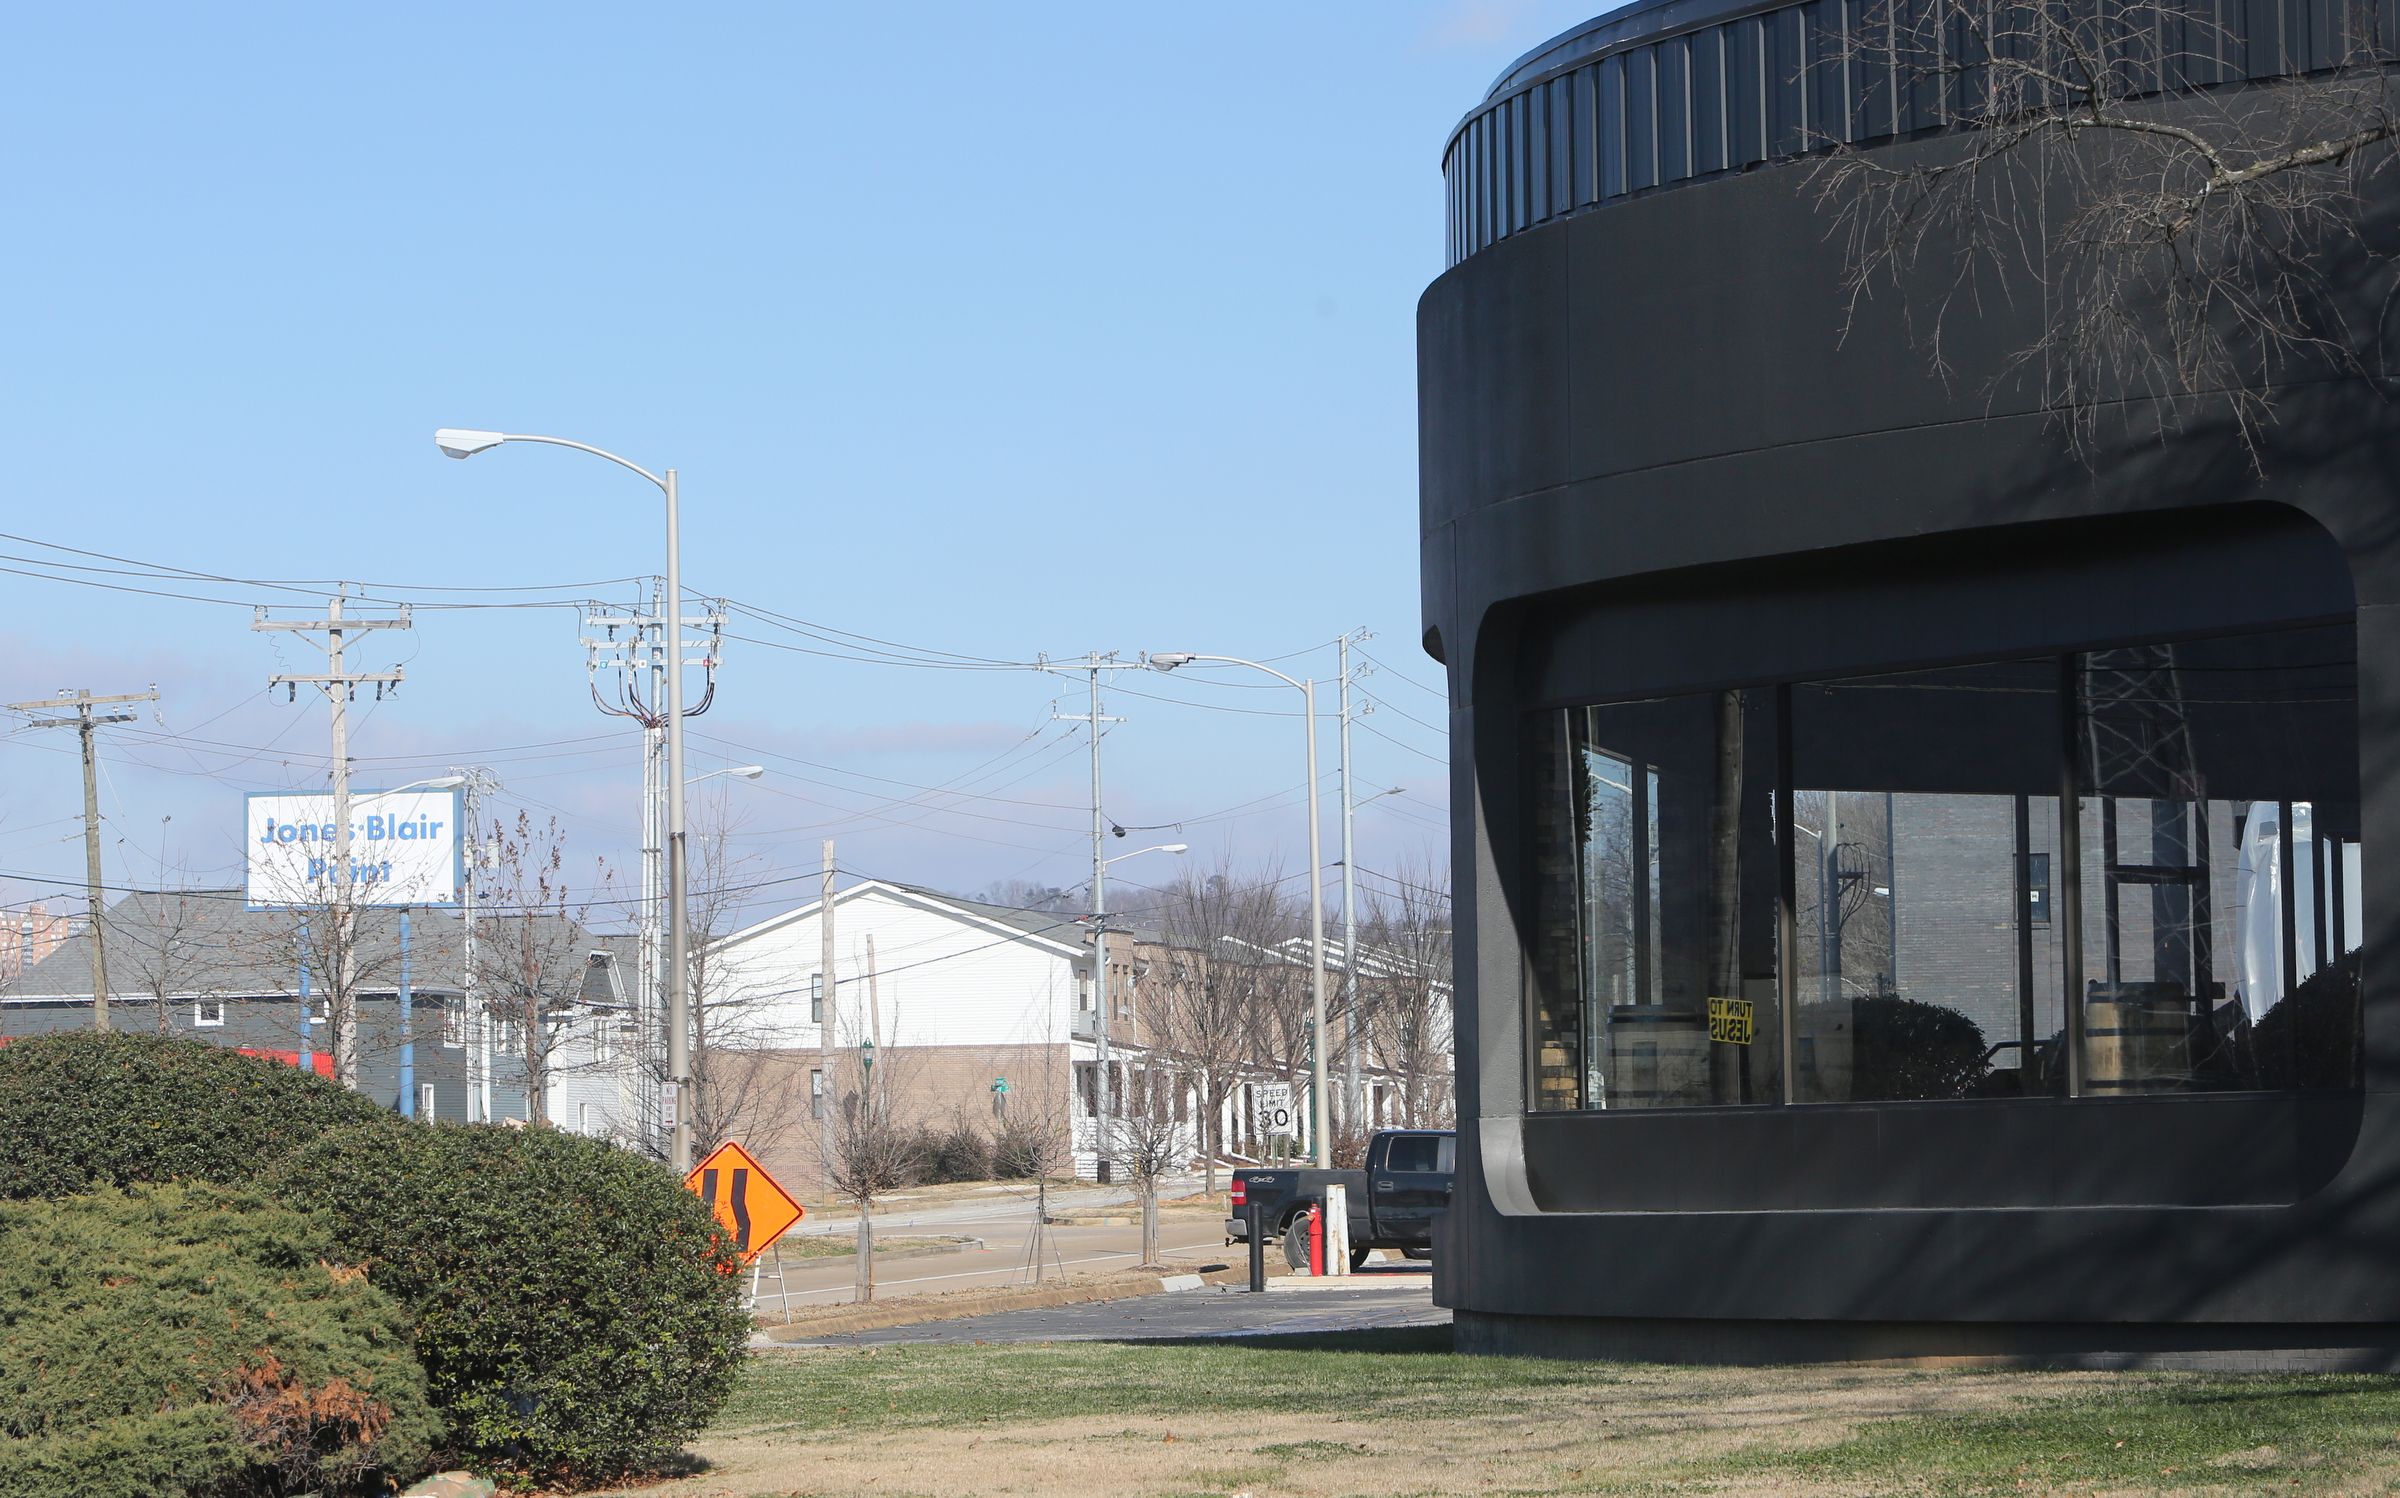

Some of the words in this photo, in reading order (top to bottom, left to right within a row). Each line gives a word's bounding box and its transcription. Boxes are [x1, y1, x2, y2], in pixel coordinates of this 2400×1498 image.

[1255, 1088, 1288, 1098] SPEED
[1260, 1099, 1284, 1107] LIMIT
[1259, 1108, 1288, 1127] 30
